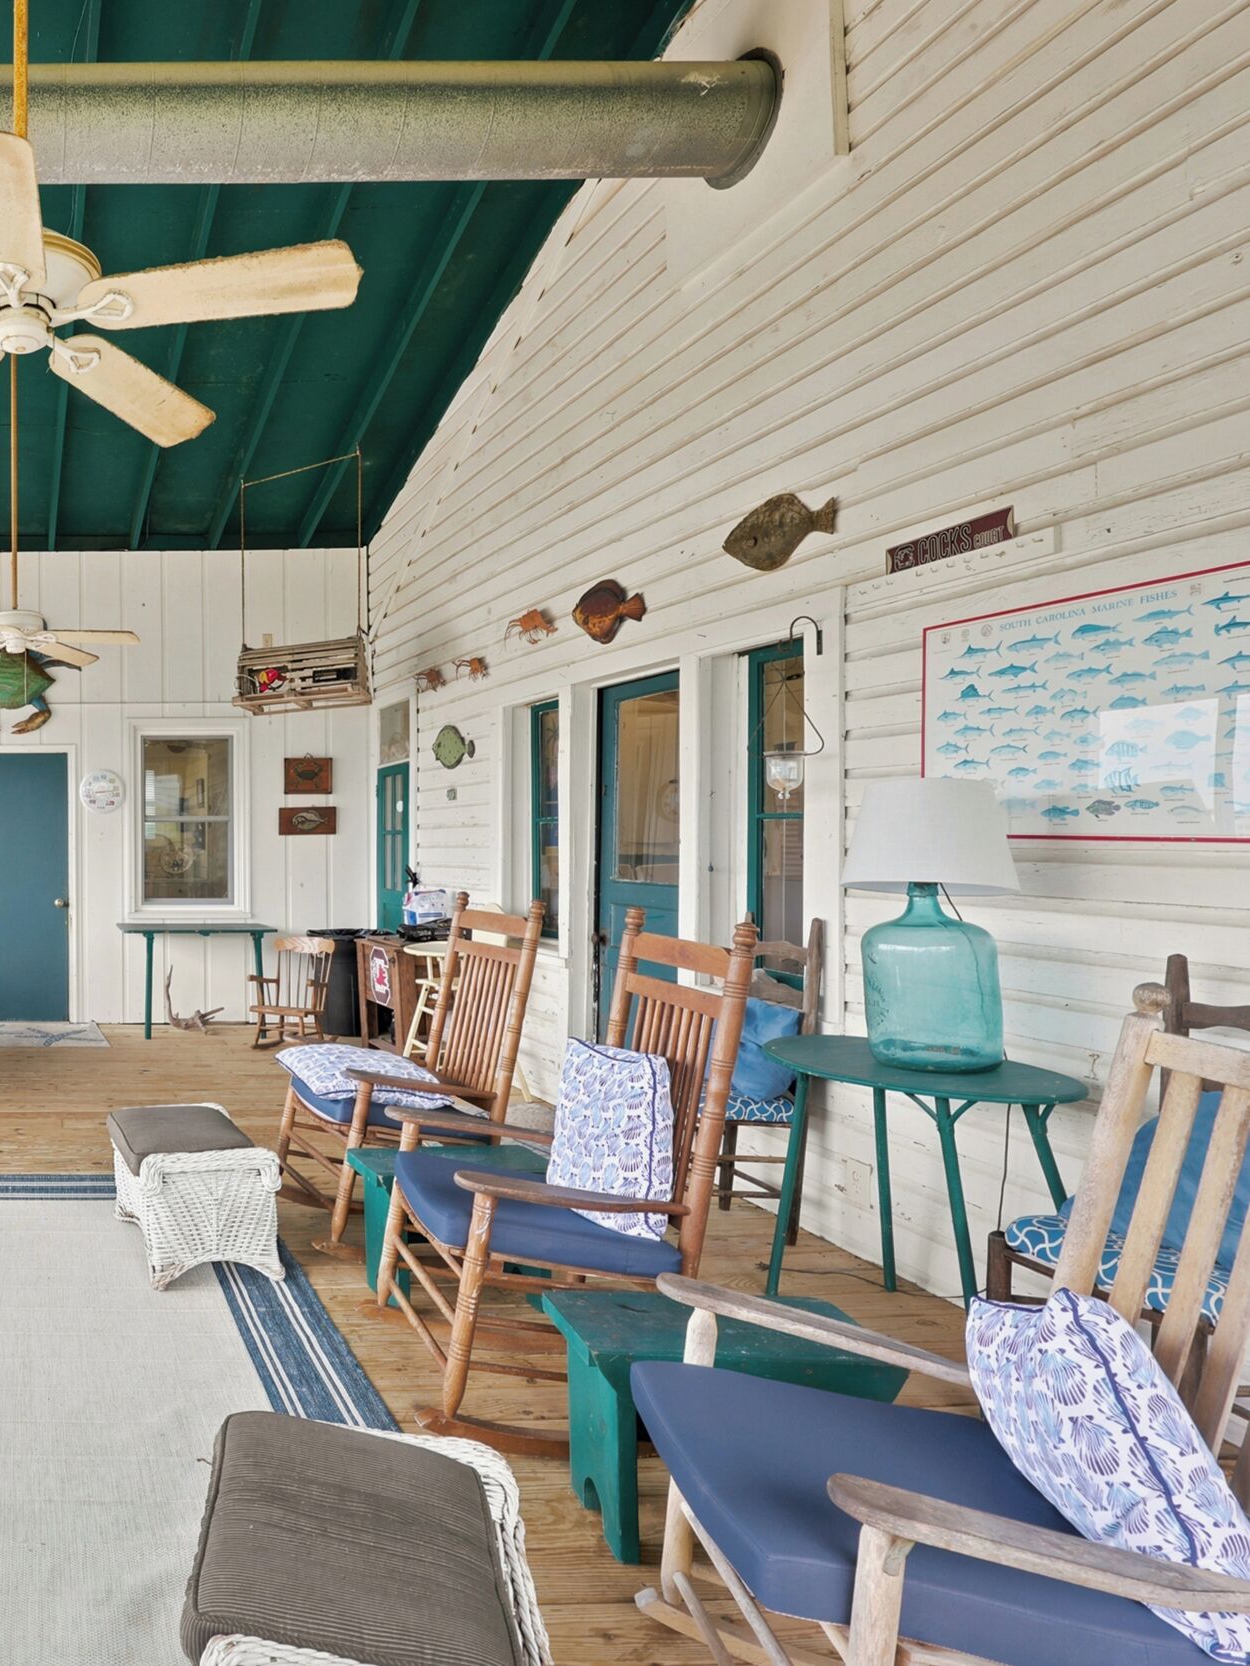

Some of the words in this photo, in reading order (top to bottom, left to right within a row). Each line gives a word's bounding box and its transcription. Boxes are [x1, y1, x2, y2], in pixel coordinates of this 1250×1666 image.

[917, 523, 972, 566] COCKS
[999, 619, 1032, 633] SOUTH
[1036, 608, 1086, 625] CAROLINA
[1091, 597, 1135, 614] MARINE
[1140, 589, 1178, 606] FISHES
